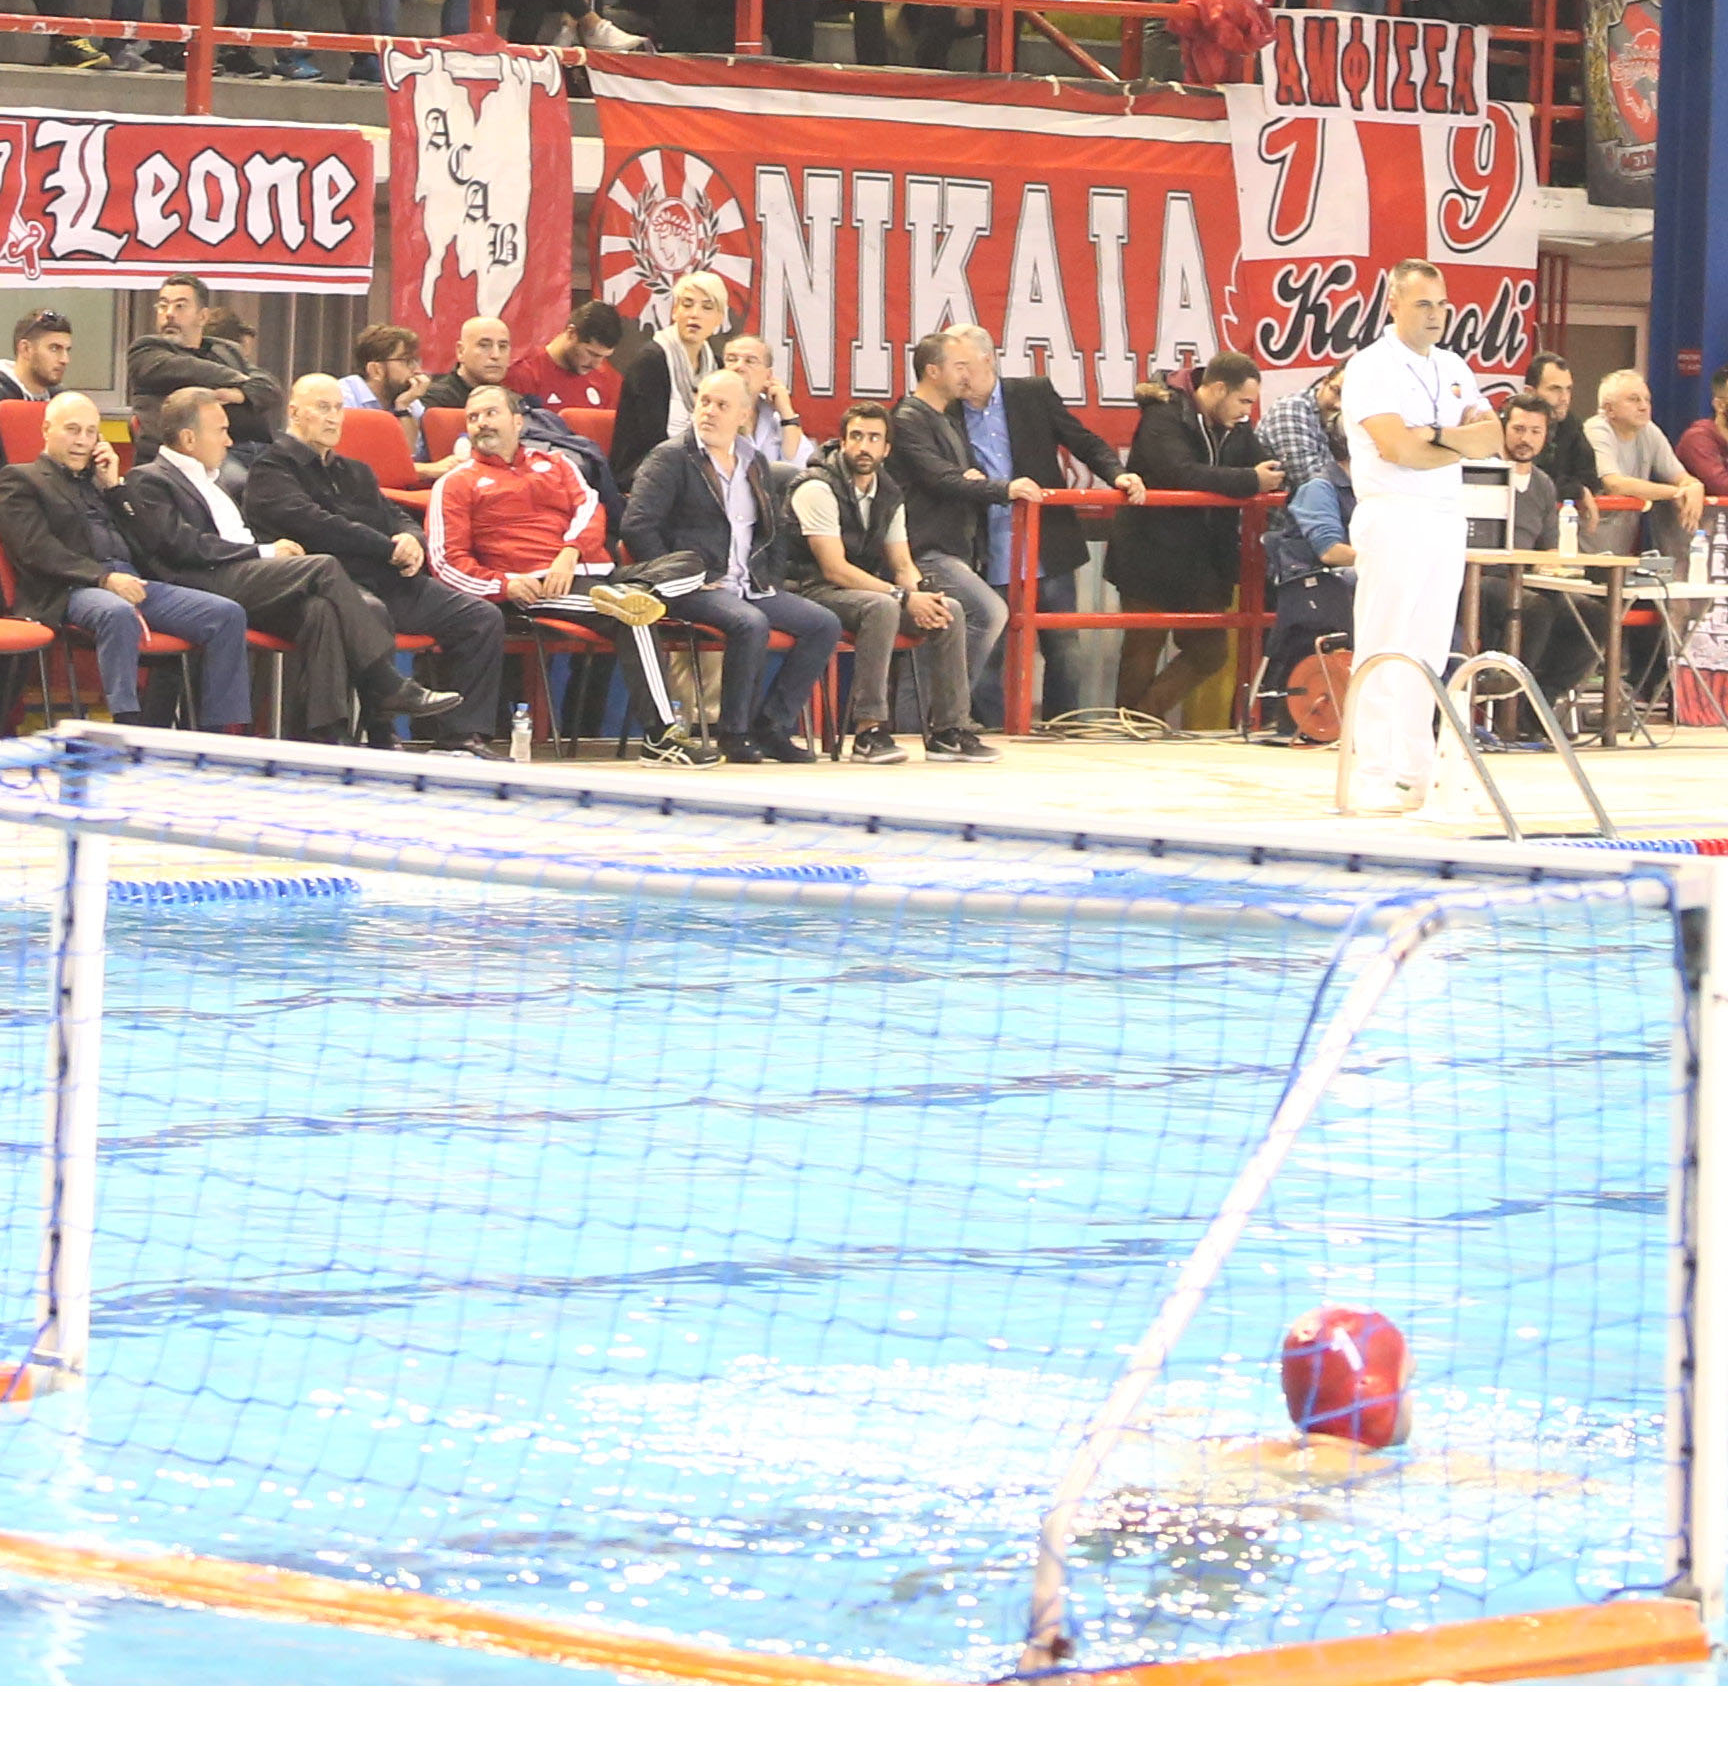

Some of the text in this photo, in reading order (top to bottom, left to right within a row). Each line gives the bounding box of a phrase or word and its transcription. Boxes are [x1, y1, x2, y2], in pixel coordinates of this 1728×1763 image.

[1274, 15, 1478, 115] ΑΜΦΙΣΣΑ
[33, 120, 359, 261] Leone
[754, 164, 1221, 408] NIKAIA
